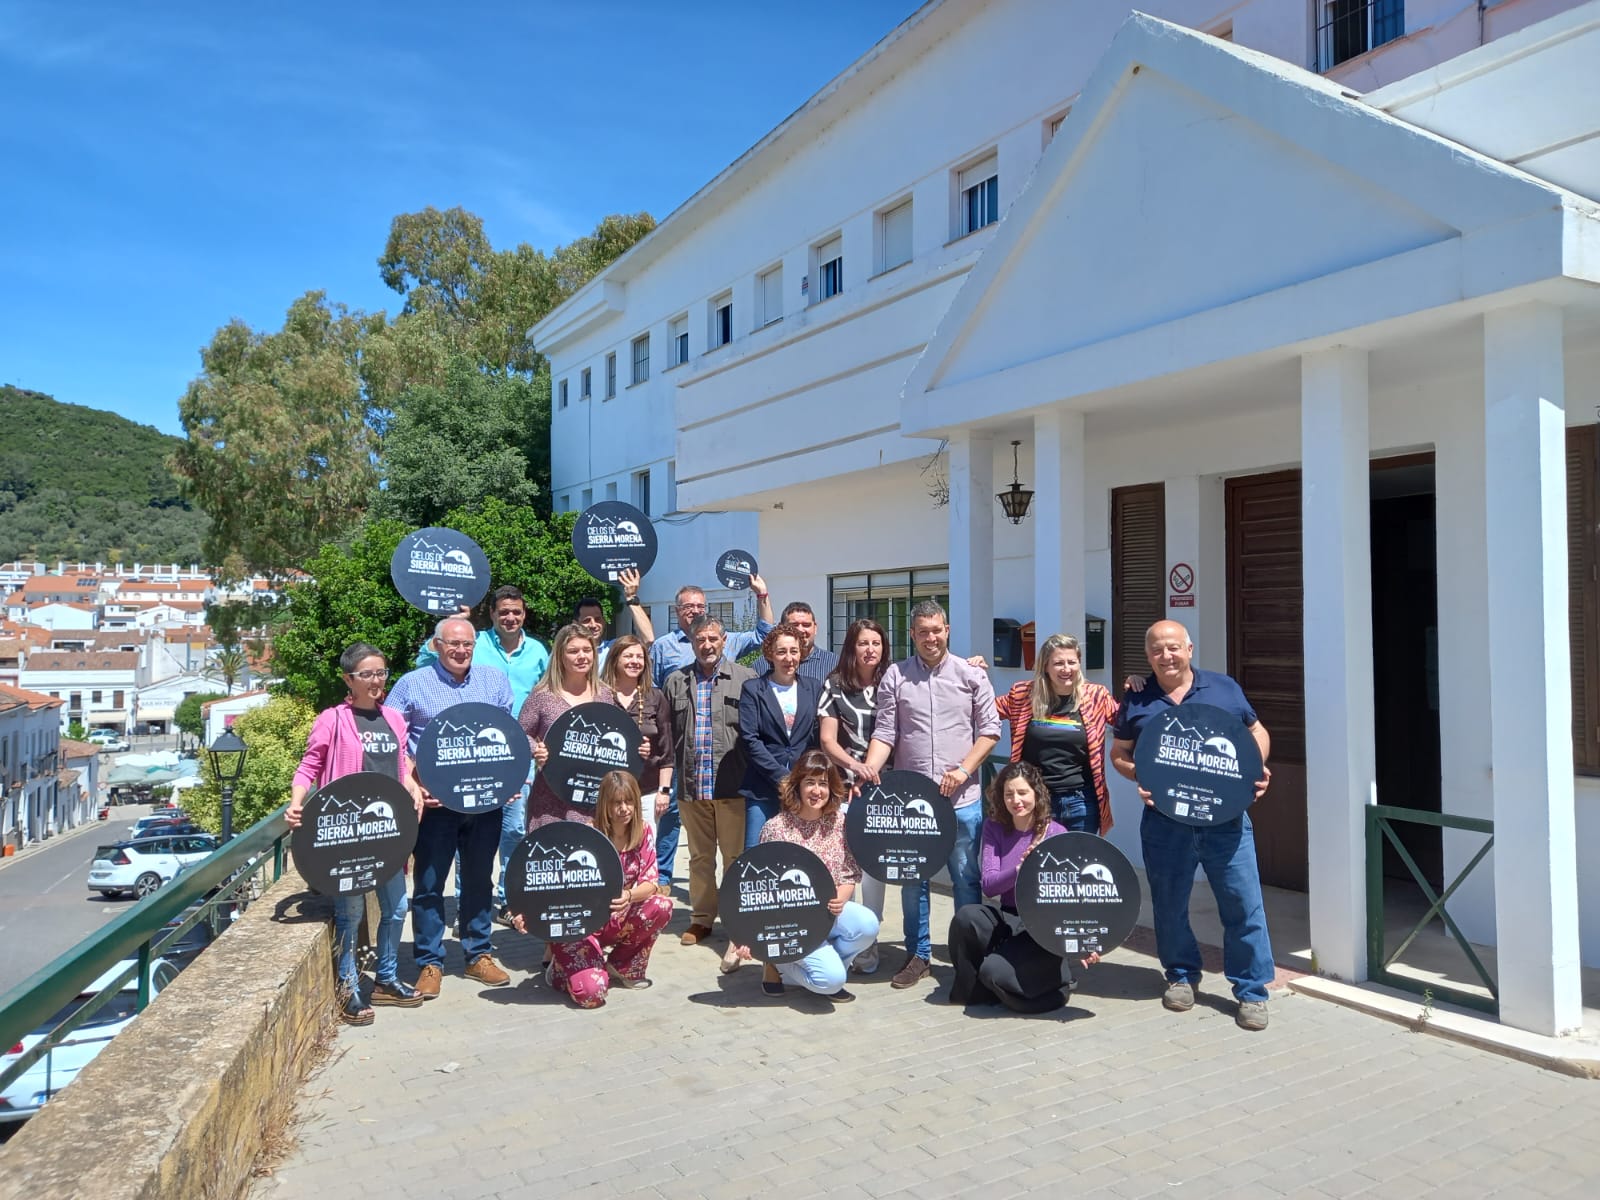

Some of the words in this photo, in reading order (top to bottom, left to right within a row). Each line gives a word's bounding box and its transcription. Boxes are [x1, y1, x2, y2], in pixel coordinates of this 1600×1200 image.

[589, 536, 613, 544] SIERRA
[615, 534, 642, 542] MORENA
[411, 551, 434, 560] CIELOS
[436, 553, 444, 562] DE
[410, 560, 439, 571] SIERRA
[441, 563, 473, 574] MORENA
[437, 736, 464, 748] CIELOS
[466, 736, 476, 746] DE
[566, 730, 590, 743] CIELOS
[590, 734, 601, 745] DE
[1161, 734, 1190, 750] CIELOS
[1192, 739, 1204, 752] DE
[382, 742, 397, 753] UP
[438, 747, 471, 760] SIERRA
[473, 744, 511, 757] MORENA
[563, 741, 592, 756] SIERRA
[594, 746, 627, 762] MORENA
[1159, 746, 1194, 764] SIERRA
[1197, 753, 1239, 772] MORENA
[867, 805, 893, 816] CIELOS
[894, 806, 904, 816] DE
[318, 813, 347, 827] CIELOS
[350, 811, 361, 823] DE
[866, 816, 898, 828] SIERRA
[901, 817, 938, 829] MORENA
[317, 825, 354, 841] SIERRA
[357, 819, 397, 836] MORENA
[526, 860, 554, 872] CIELOS
[555, 859, 566, 870] DE
[526, 872, 560, 885] SIERRA
[562, 869, 601, 883] MORENA
[1038, 872, 1067, 883] CIELOS
[1069, 872, 1080, 883] DE
[740, 880, 767, 893] CIELOS
[769, 879, 779, 890] DE
[1039, 885, 1075, 897] SIERRA
[1077, 884, 1118, 896] MORENA
[741, 892, 774, 906] SIERRA
[777, 887, 816, 902] MORENA
